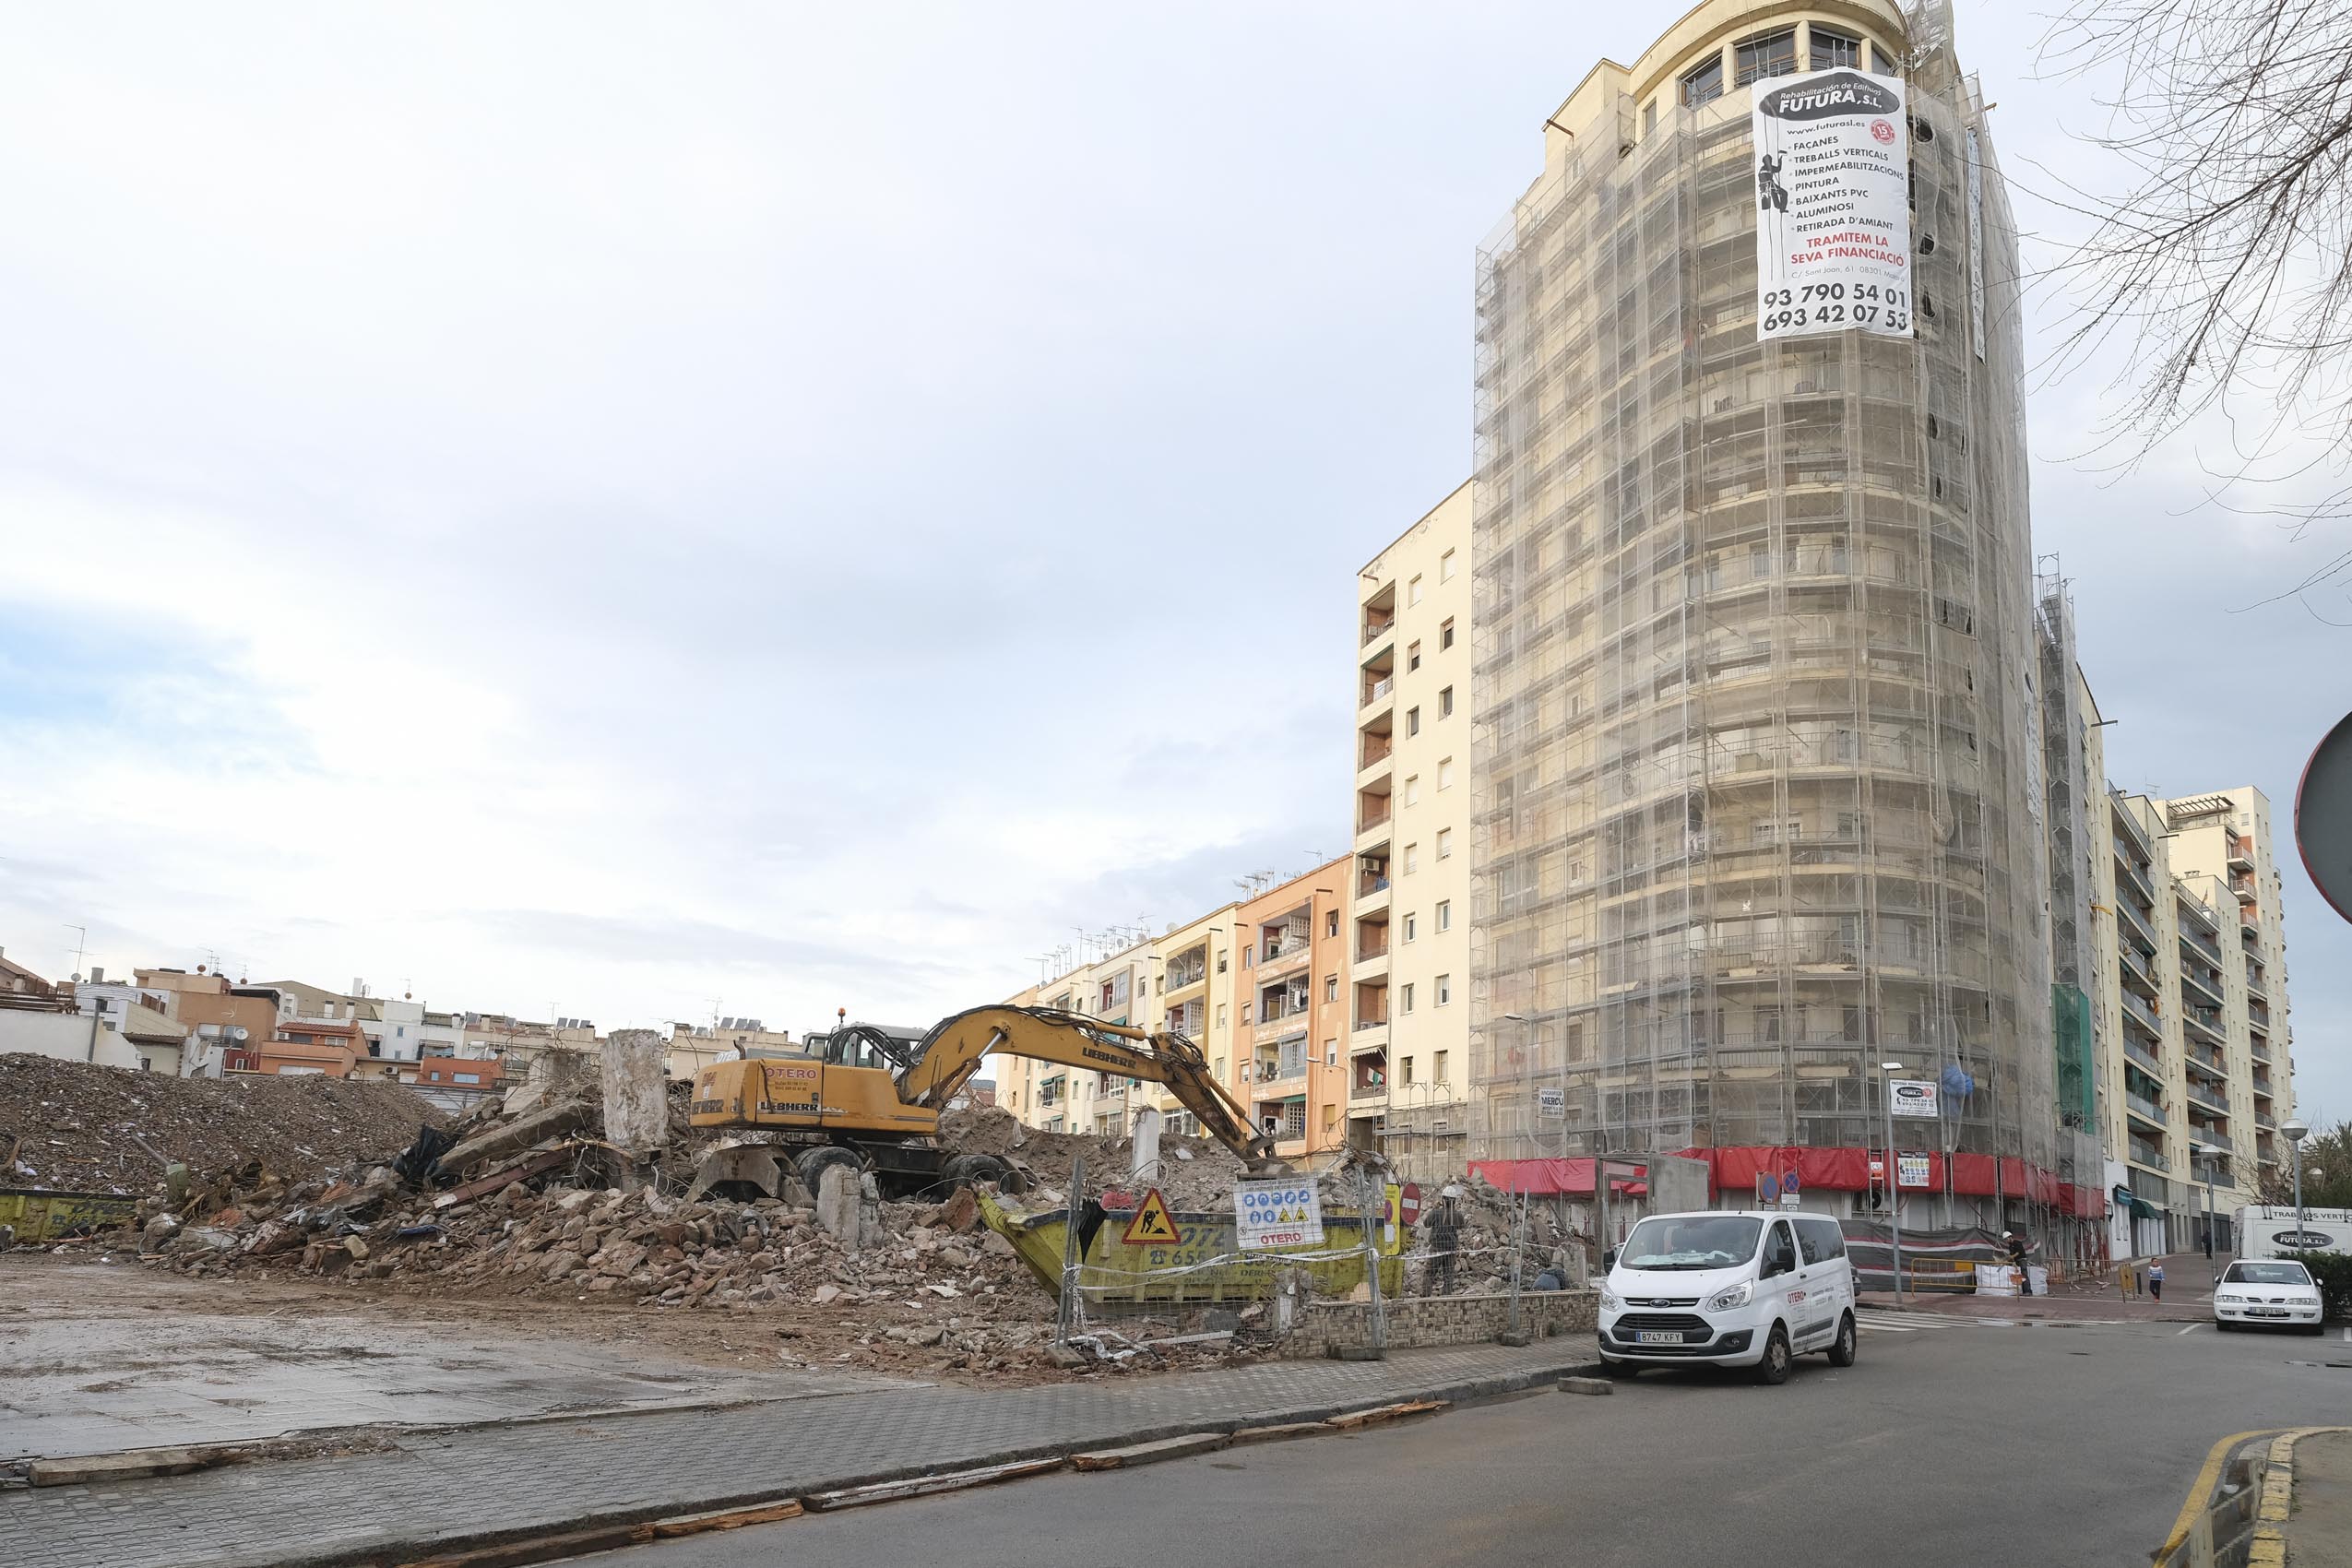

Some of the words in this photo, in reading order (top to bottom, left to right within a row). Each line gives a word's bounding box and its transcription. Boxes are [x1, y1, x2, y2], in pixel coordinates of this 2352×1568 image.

[1780, 83, 1839, 100] Rehabilitación
[1841, 82, 1852, 90] de
[1862, 94, 1883, 109] S.L.
[1787, 119, 1865, 135] www.futurasl.es
[1877, 125, 1888, 135] 15
[1794, 137, 1838, 150] FAÇANES
[1794, 148, 1840, 163] TREBALLS
[1843, 148, 1889, 161] VERTICALS
[1795, 161, 1904, 181] IMPERMEABILITZACIONS
[1795, 176, 1839, 192] PINTURA
[1796, 188, 1847, 206] BAIXANTS
[1850, 189, 1869, 198] PVC
[1796, 203, 1854, 219] ALUMINOSI
[1797, 218, 1846, 232] RETIRADA
[1848, 216, 1894, 231] D'AMIANT
[1806, 232, 1871, 248] TRAMITEM
[1875, 235, 1889, 247] LA
[1791, 251, 1823, 265] SEVA
[1828, 247, 1905, 267] FINANCIACIÓ
[1764, 289, 1792, 309] 93
[1801, 282, 1845, 303] 790
[1853, 283, 1880, 302] 54
[1885, 288, 1906, 308] 01
[1764, 308, 1807, 331] 693
[1815, 304, 1845, 324] 42
[1852, 304, 1880, 323] 07
[1885, 309, 1908, 331] 53
[1082, 1046, 1137, 1069] LIEBHERR
[766, 1067, 817, 1079] OTERO
[2273, 1211, 2319, 1220] TRABOS
[1260, 1232, 1301, 1245] OTERO
[1788, 1291, 1804, 1304] OTERO
[1642, 1333, 1661, 1342] 8747
[1664, 1333, 1680, 1342] KFY
